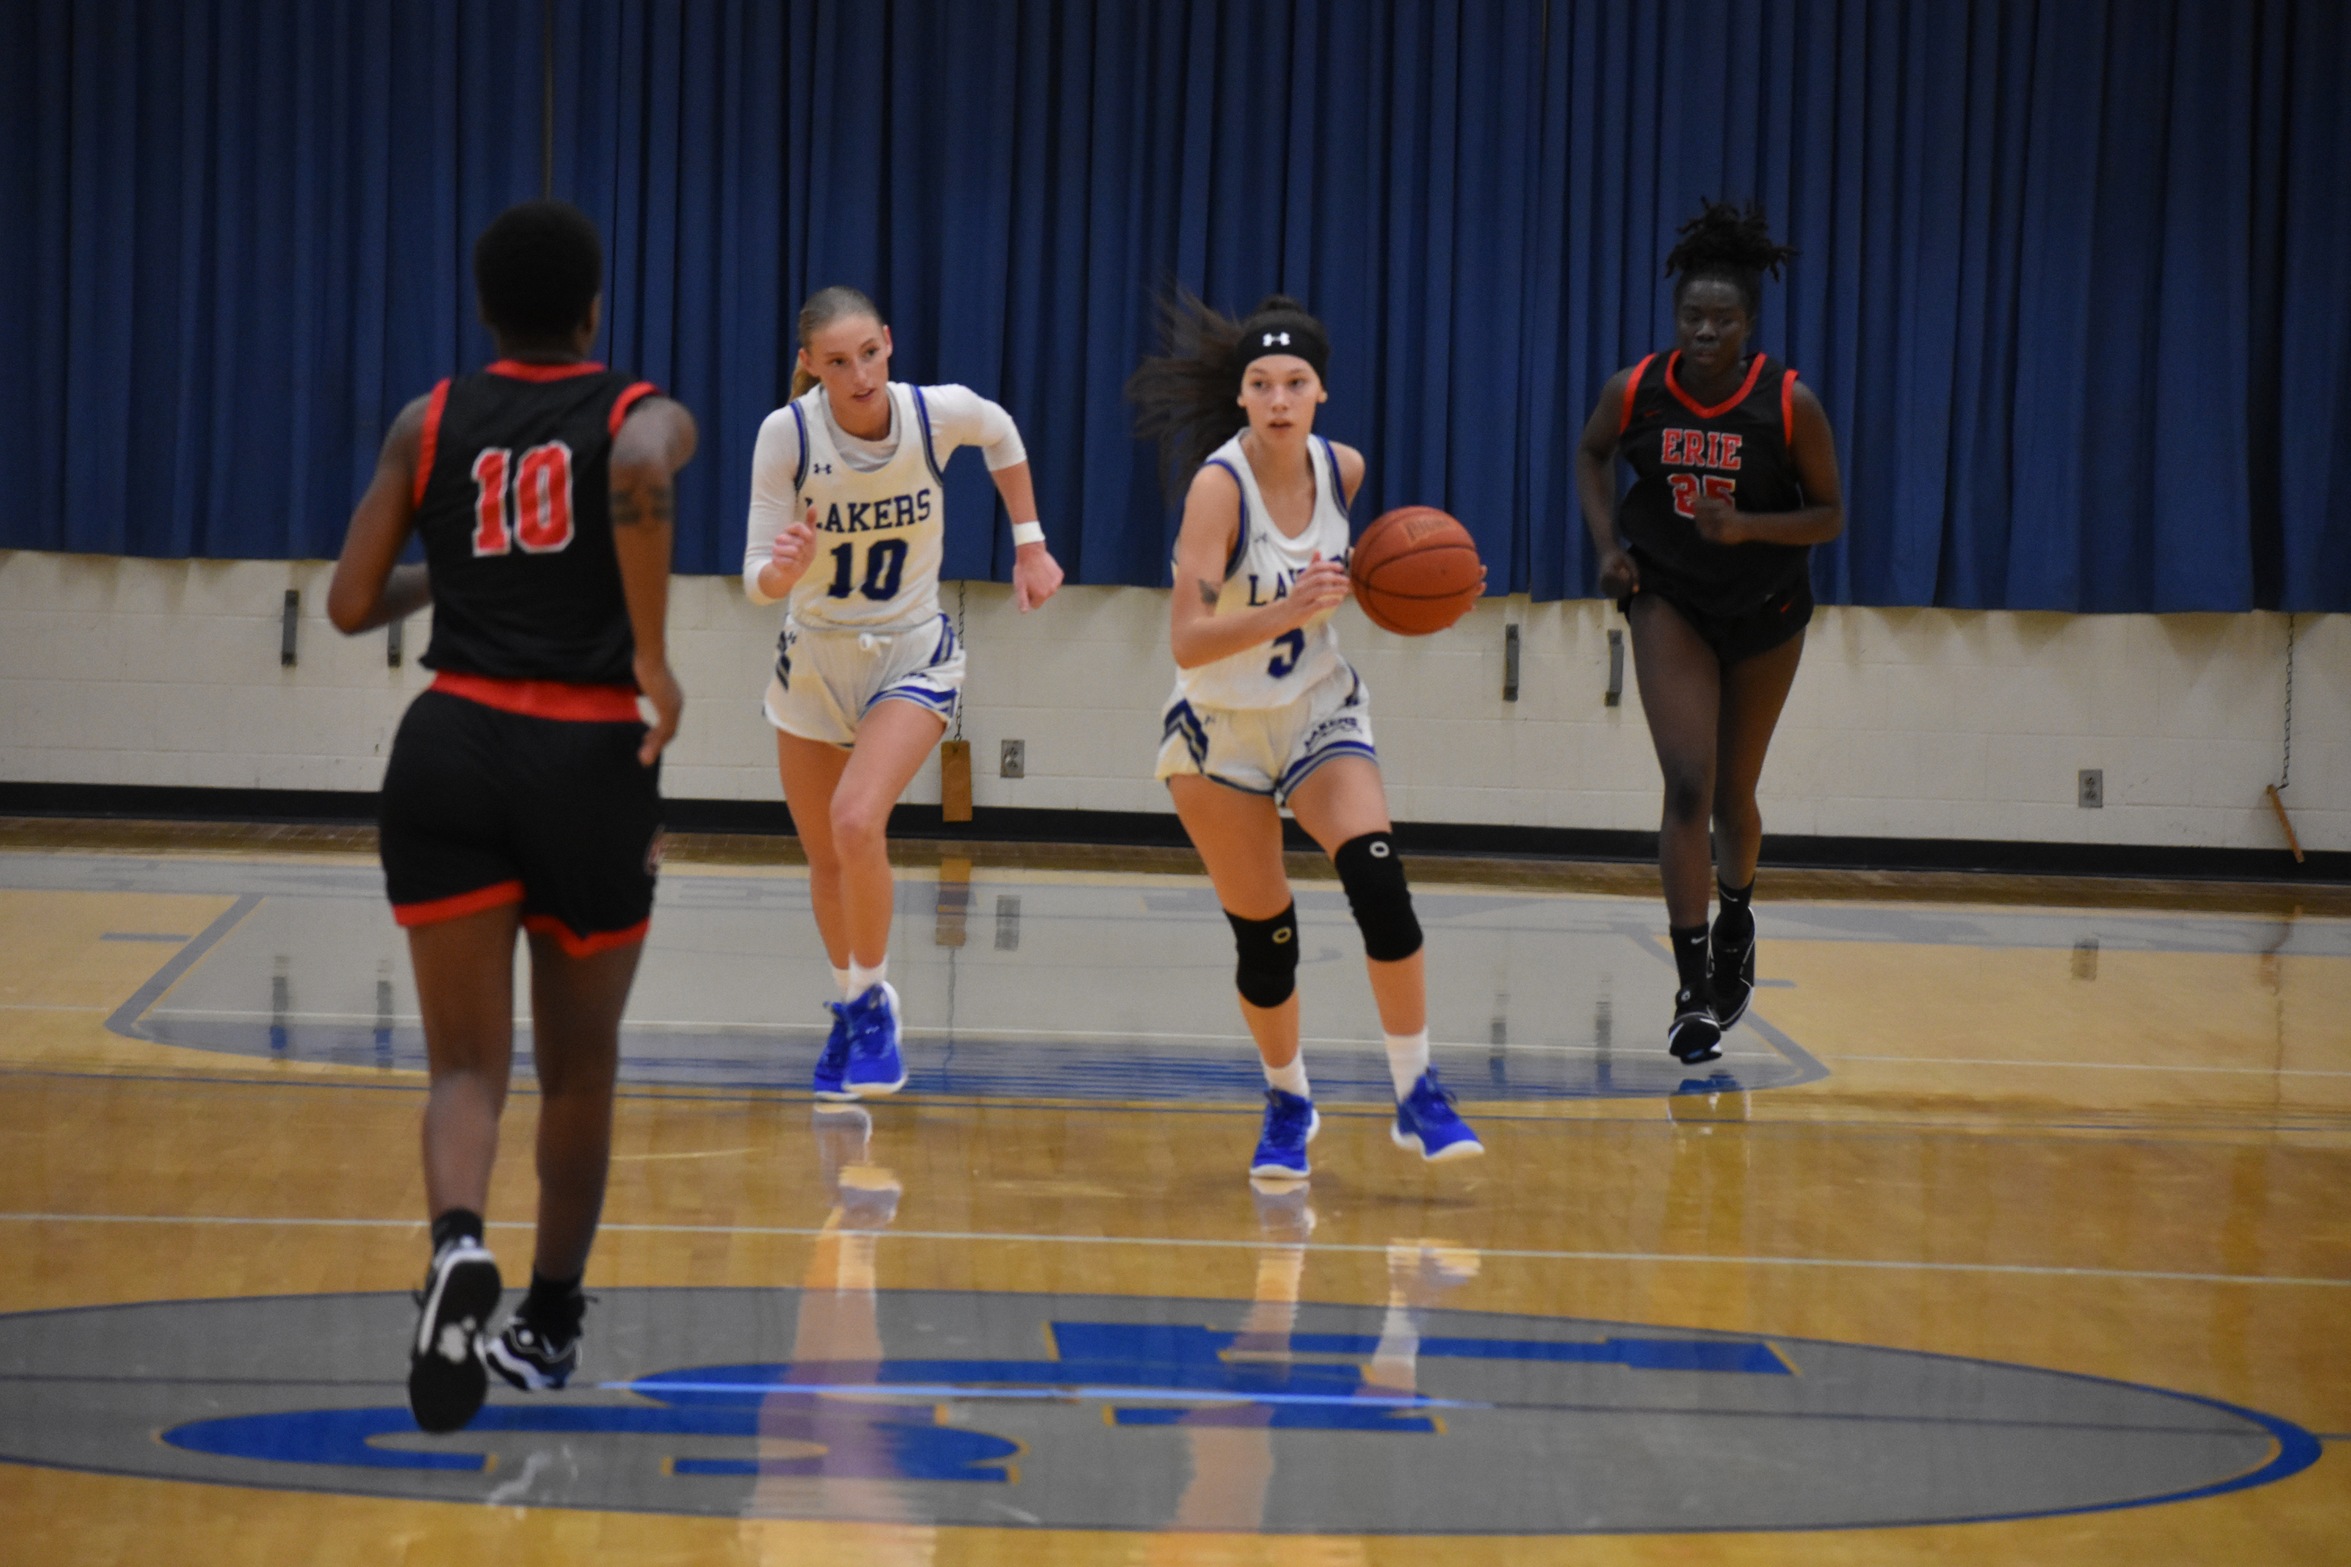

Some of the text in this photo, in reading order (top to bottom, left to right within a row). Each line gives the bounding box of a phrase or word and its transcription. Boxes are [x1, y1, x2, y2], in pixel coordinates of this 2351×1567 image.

[1661, 428, 1742, 470] ERIE
[471, 440, 575, 558] 10
[1667, 473, 1736, 519] 25
[827, 537, 908, 601] 10
